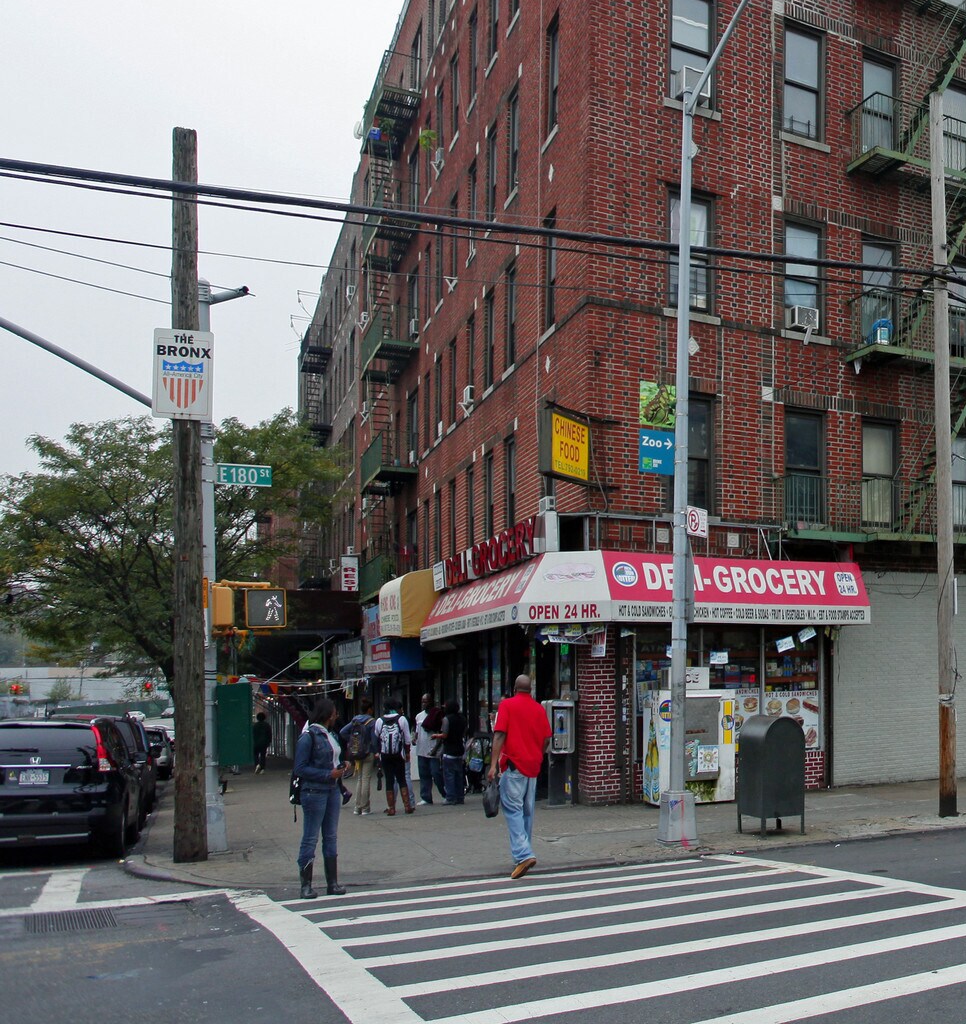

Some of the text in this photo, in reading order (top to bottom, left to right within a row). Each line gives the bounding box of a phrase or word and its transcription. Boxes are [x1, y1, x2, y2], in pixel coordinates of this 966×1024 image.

[174, 334, 194, 345] THE
[156, 344, 211, 359] BRONX
[554, 417, 586, 445] CHINESE
[642, 435, 663, 448] Zoo
[560, 440, 580, 463] FOOD
[220, 466, 270, 484] E 180 St
[641, 562, 826, 596] DEI-GROCERY
[836, 573, 853, 582] OPEN
[528, 603, 601, 620] OPEN 24 HR.
[619, 605, 627, 616] HOT
[631, 606, 641, 617] COLD
[642, 606, 666, 618] SANDWICHES
[712, 607, 720, 619] HOT
[720, 607, 733, 619] COFFEE
